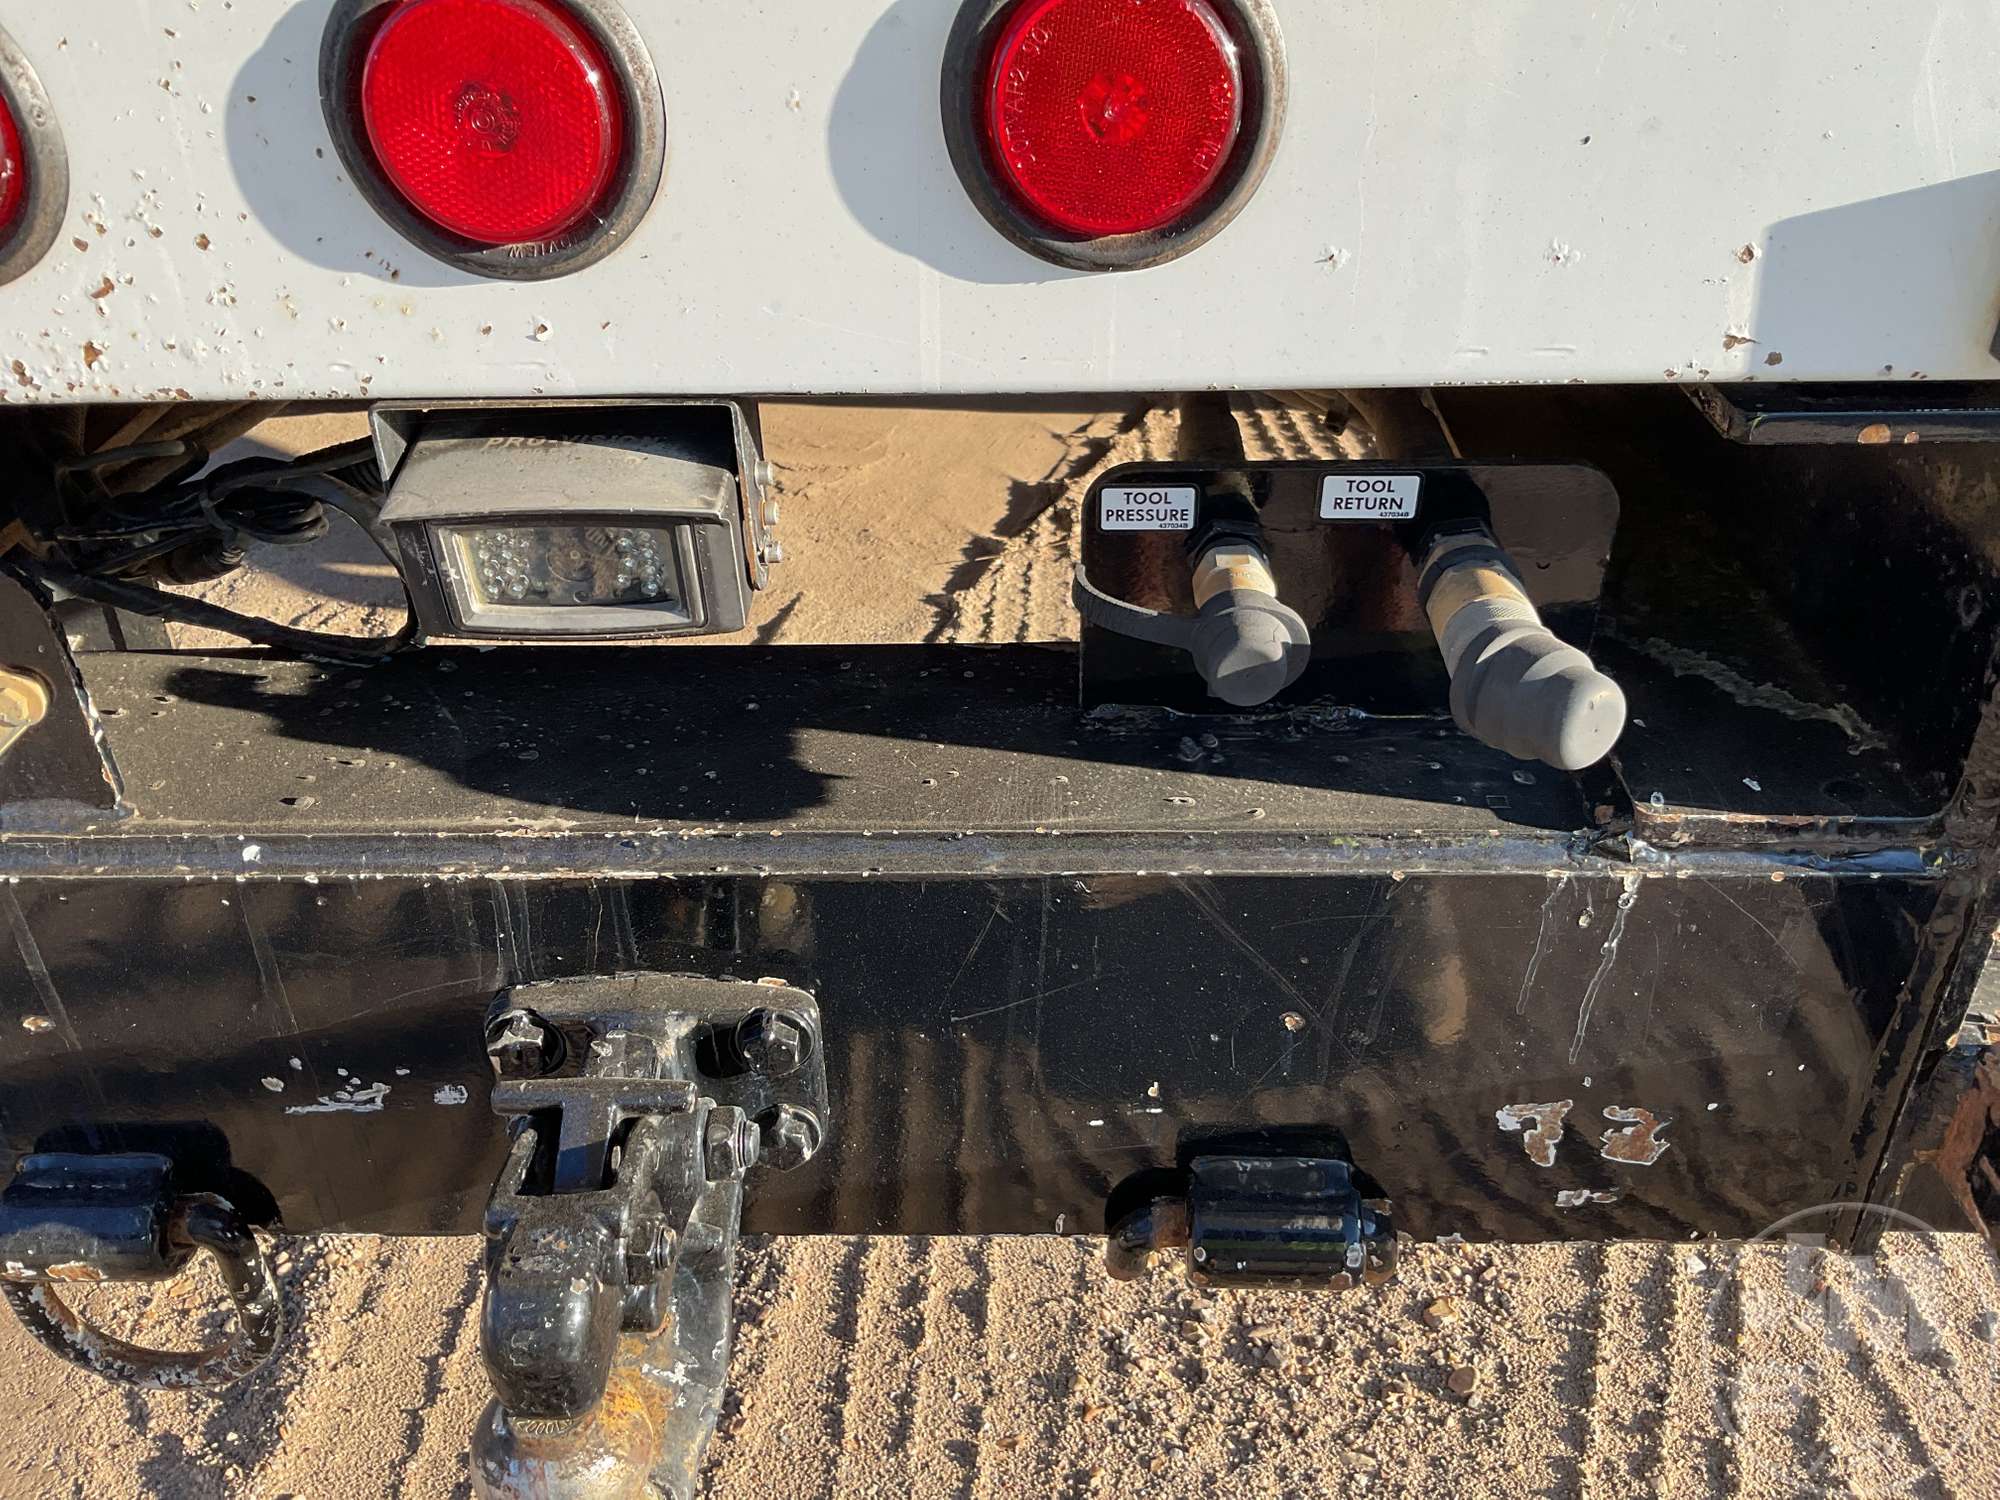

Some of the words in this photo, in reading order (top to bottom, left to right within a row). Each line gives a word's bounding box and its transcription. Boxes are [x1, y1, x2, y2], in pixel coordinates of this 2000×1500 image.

[1346, 479, 1395, 493] TOOL
[1124, 491, 1172, 505] TOOL
[1332, 496, 1404, 510] RETURN
[1106, 508, 1189, 522] PRESSURE
